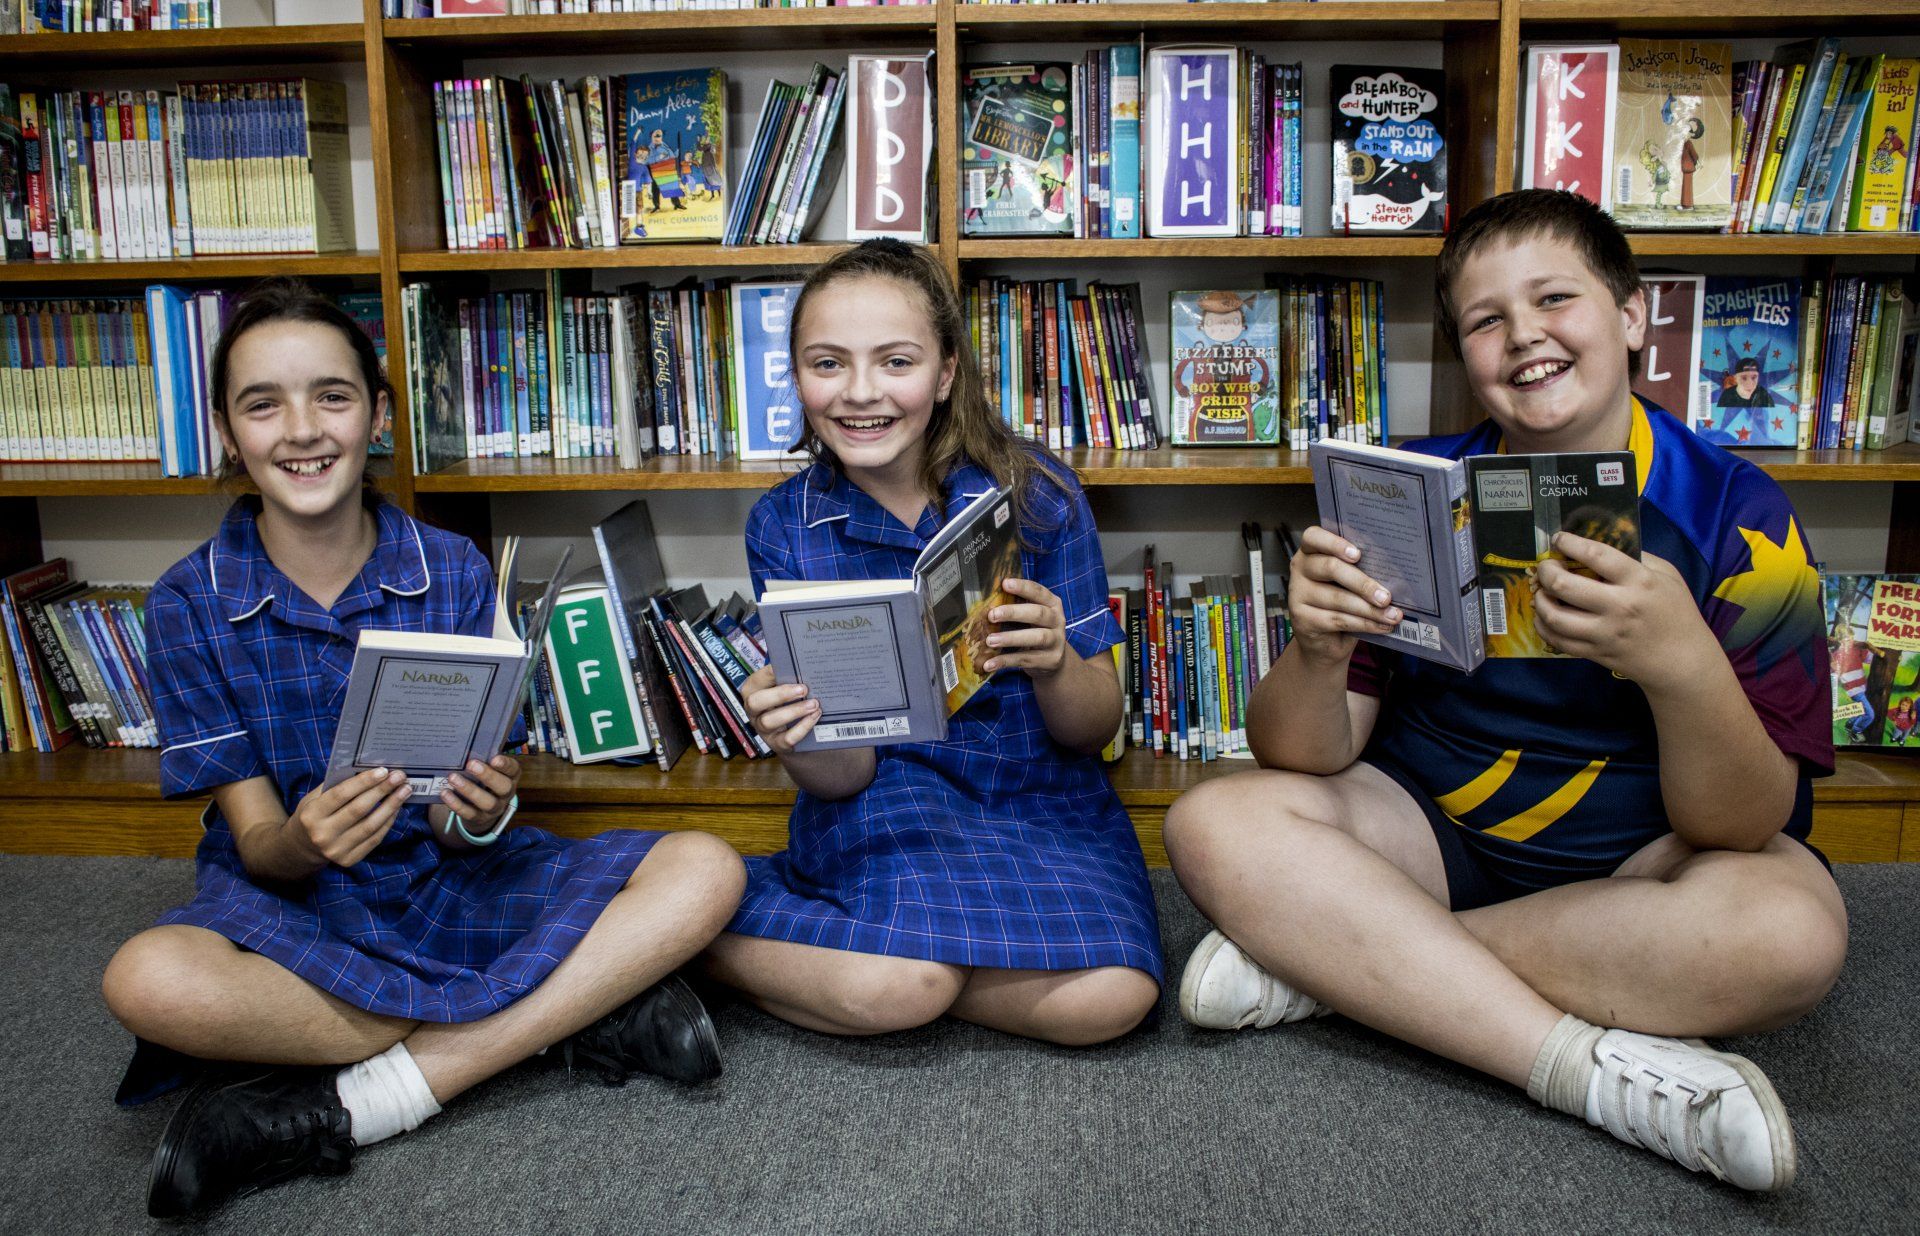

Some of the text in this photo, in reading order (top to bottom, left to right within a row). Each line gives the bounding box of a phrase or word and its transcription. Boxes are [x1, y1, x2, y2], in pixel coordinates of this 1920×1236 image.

[1627, 48, 1724, 76] Jackson Jones
[879, 73, 906, 107] D
[1181, 64, 1211, 101] H
[1560, 62, 1585, 100] K
[1786, 80, 1801, 107] NANCY
[1876, 80, 1914, 101] night
[631, 94, 700, 127] Danny Allen
[1362, 99, 1419, 116] HUNTER
[1781, 108, 1794, 130] DREW
[1252, 114, 1260, 129] Days
[1365, 125, 1433, 139] STAND OUT
[877, 131, 905, 165] D
[975, 122, 1039, 158] LIBRARY
[1180, 122, 1211, 159] H
[1373, 142, 1387, 151] the
[1557, 121, 1583, 157] K
[31, 175, 39, 195] PETER
[875, 186, 904, 223] D
[1180, 180, 1211, 217] H
[1376, 203, 1412, 214] Steven
[671, 215, 718, 224] CUMMINGS
[1371, 214, 1414, 224] Herrick
[1651, 285, 1674, 326] L
[1705, 283, 1789, 315] SPAGHETTI
[761, 296, 787, 333] E
[1703, 316, 1748, 327] ohn Larkin
[1753, 302, 1791, 326] LEGS
[528, 342, 536, 371] ELEPHANT
[563, 312, 574, 387] Robinson Crusoe
[1174, 346, 1278, 360] FIZZLEBERT
[764, 351, 788, 389] E
[1048, 356, 1056, 371] MAD
[1196, 360, 1256, 375] STUMP
[1647, 345, 1671, 382] L
[1189, 383, 1261, 394] BOY WHO
[1201, 395, 1248, 406] CRIED
[766, 405, 791, 442] E
[1207, 408, 1242, 418] FISH
[1349, 475, 1408, 500] NARNIA
[1539, 474, 1578, 485] PRINCE
[1539, 486, 1588, 497] CASPIAN
[1485, 490, 1525, 498] NARNIA
[962, 531, 985, 556] PRINCE
[964, 536, 992, 564] CASPIAN
[564, 608, 588, 644] F
[807, 615, 872, 632] NARNIA
[1132, 619, 1139, 633] AM
[1185, 625, 1192, 640] AM
[31, 621, 43, 640] ANGEL
[47, 657, 58, 669] THE
[36, 613, 46, 626] THE
[43, 628, 56, 647] ANGEL
[53, 649, 63, 661] AND
[58, 664, 69, 675] THE
[1132, 635, 1140, 660] DAVID
[1185, 641, 1194, 667] DAVID
[647, 620, 658, 640] BIONICLE
[672, 676, 680, 695] Legends
[1150, 642, 1159, 678] NINJA
[400, 670, 471, 685] NARNIA
[578, 660, 601, 695] F
[721, 662, 743, 681] WAY
[1152, 680, 1160, 716] FILES
[589, 710, 613, 745] F
